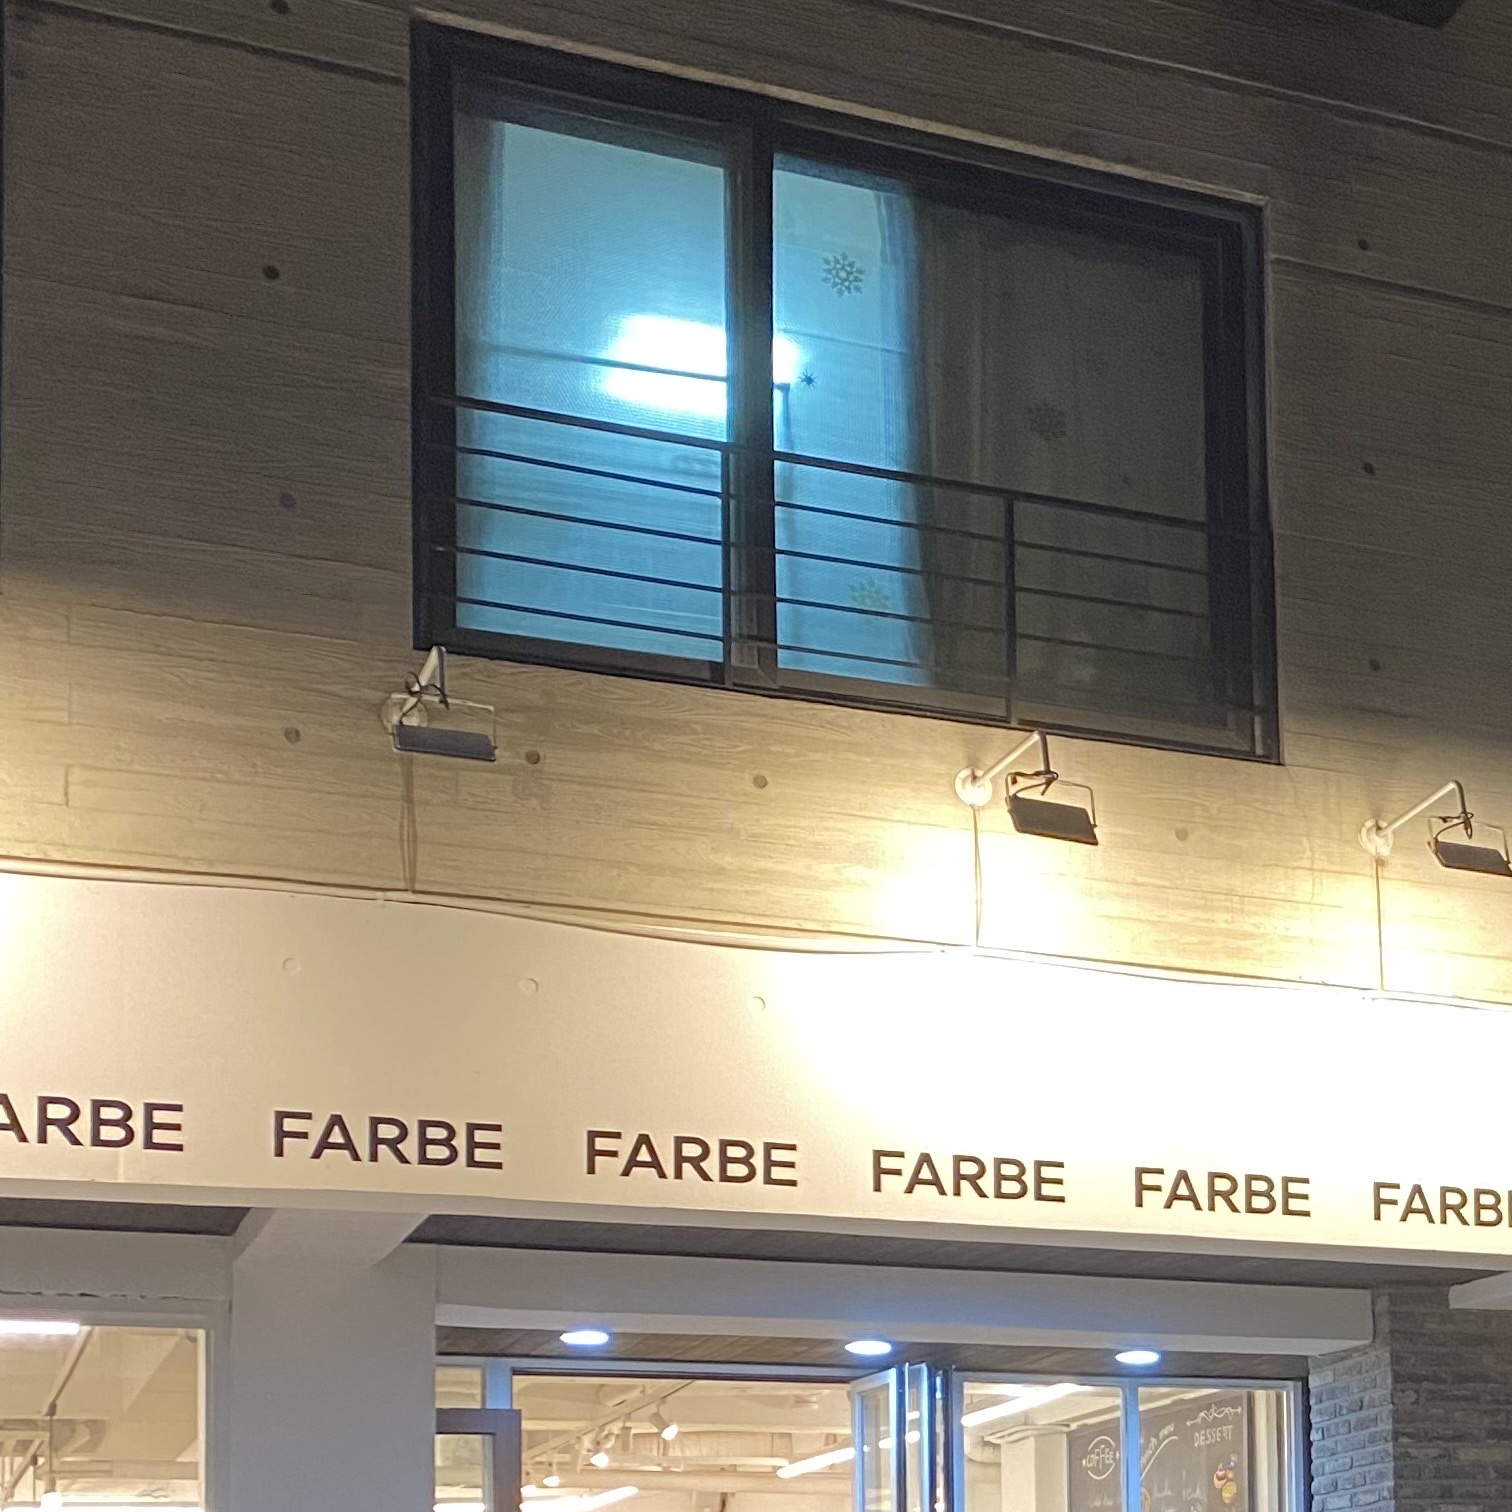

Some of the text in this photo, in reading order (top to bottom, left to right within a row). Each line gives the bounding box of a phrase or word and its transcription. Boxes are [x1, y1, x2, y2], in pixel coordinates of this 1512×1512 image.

[273, 1109, 503, 1171] FARBE
[585, 1129, 798, 1188] FARBE
[872, 1148, 1067, 1204] FARBE
[1133, 1166, 1312, 1218] FARBE
[1193, 1424, 1234, 1448] DESSERT
[1086, 1444, 1115, 1469] COFFEE
